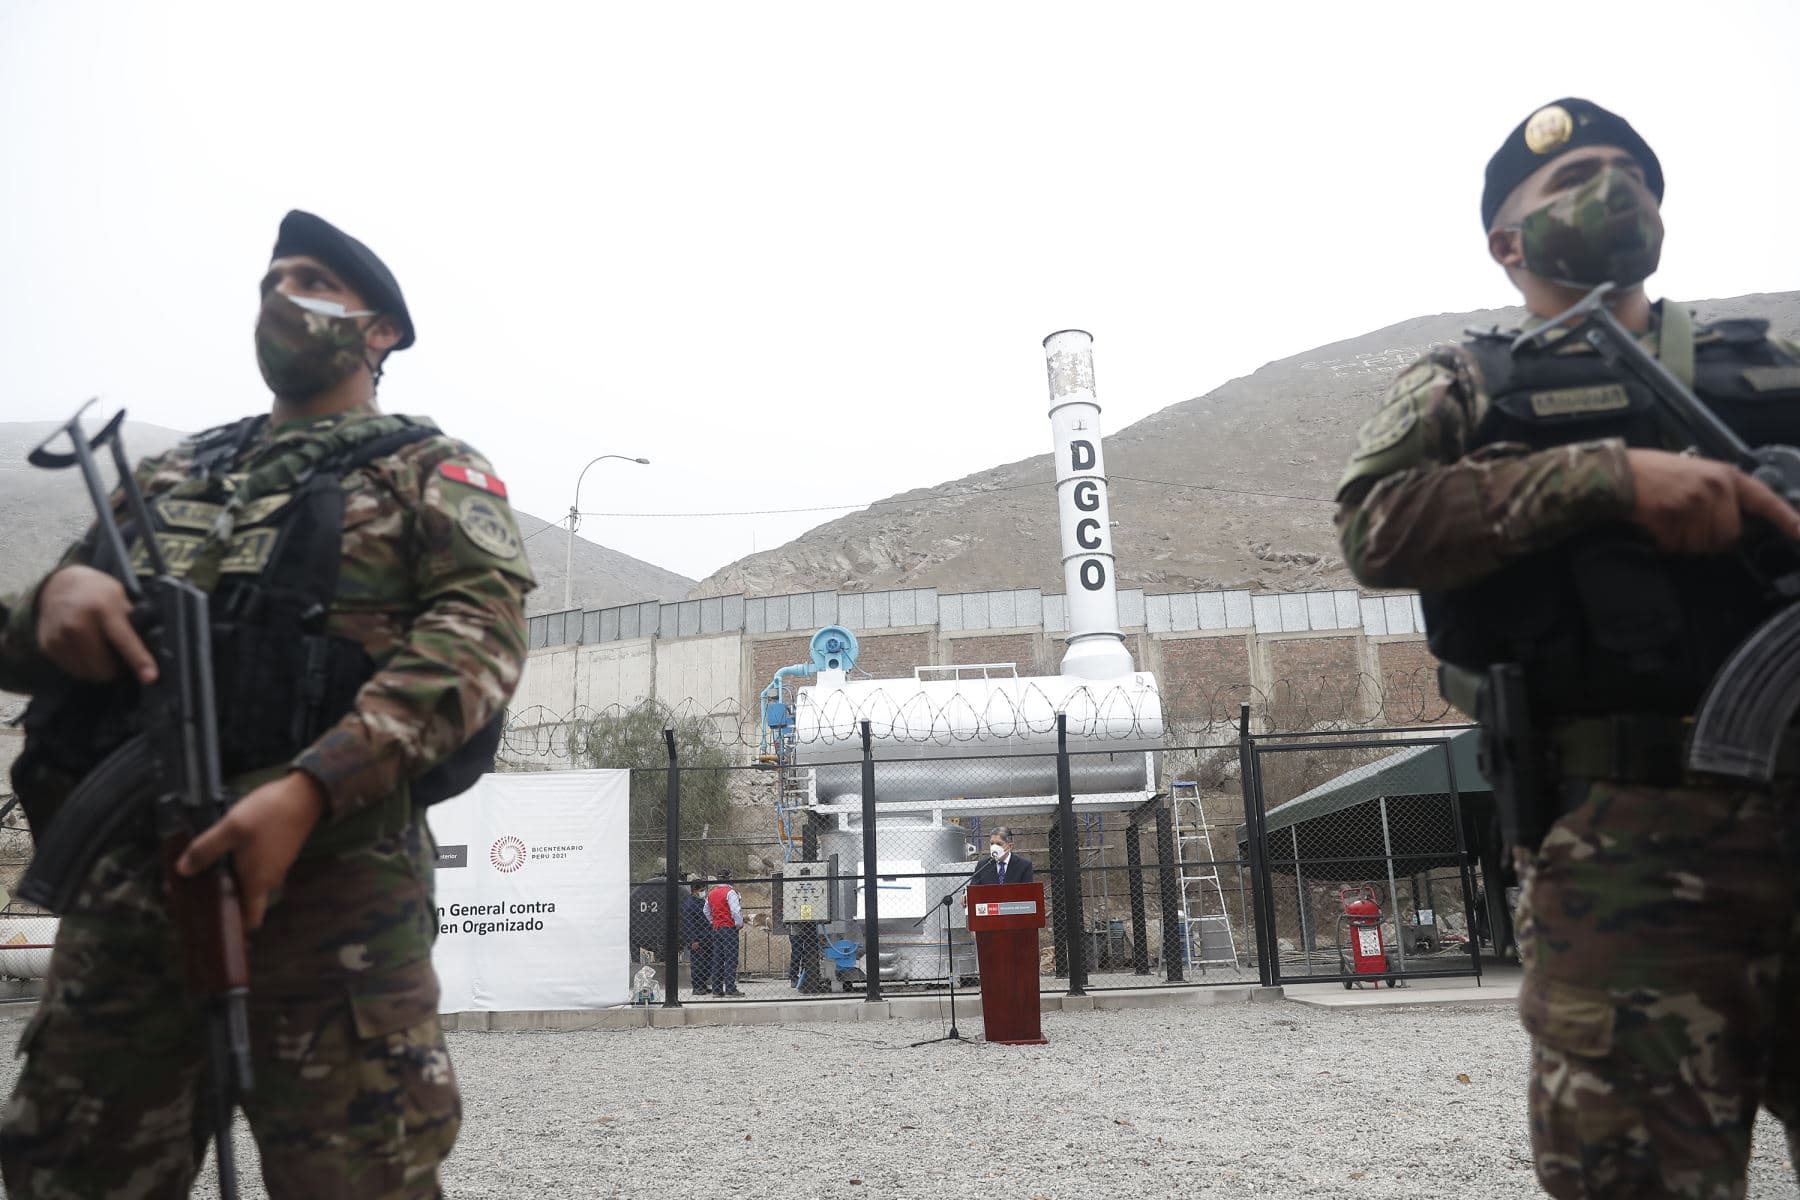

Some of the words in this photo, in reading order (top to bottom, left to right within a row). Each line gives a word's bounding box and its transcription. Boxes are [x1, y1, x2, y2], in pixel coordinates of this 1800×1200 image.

[531, 845, 584, 853] BICENTENARIO
[450, 901, 505, 917] General
[509, 901, 556, 914] contra
[440, 923, 458, 934] en
[462, 917, 544, 936] Organizado
